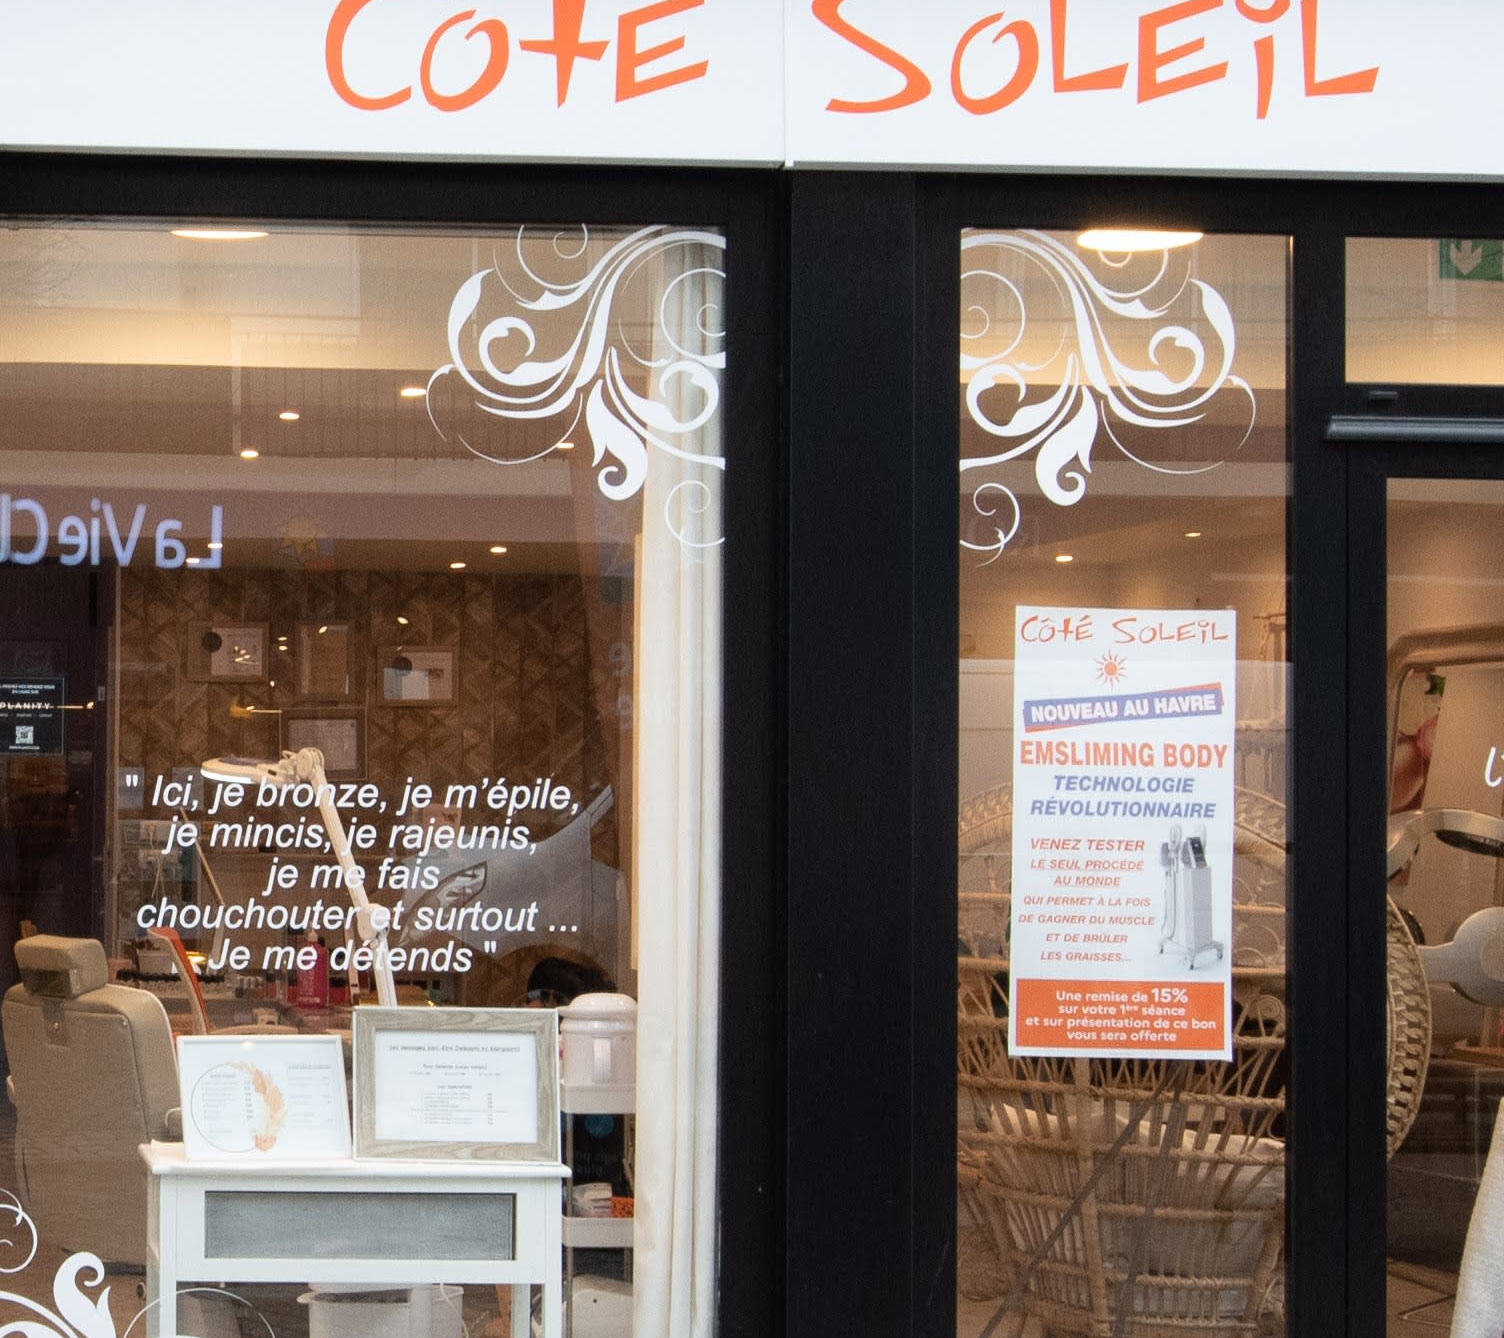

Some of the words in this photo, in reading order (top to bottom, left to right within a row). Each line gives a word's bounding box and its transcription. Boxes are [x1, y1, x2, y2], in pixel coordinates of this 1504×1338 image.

[1031, 701, 1118, 723] NOUVEAU
[1124, 699, 1149, 716] AU
[1154, 694, 1216, 714] HAVRE
[1020, 740, 1154, 767] EMSLIMING
[1163, 743, 1228, 769] BODY
[1054, 775, 1195, 793] TECHNOLOGIE
[151, 774, 199, 812] Ici,
[208, 779, 245, 813] je
[256, 778, 388, 813] bronze,
[396, 780, 433, 816] je
[1030, 796, 1216, 819] RÉVOLUTIONNAIRE
[162, 816, 198, 855] je
[209, 817, 331, 853] mincis,
[340, 818, 378, 856] je
[388, 820, 538, 856] rajeunis,
[1030, 838, 1082, 850] VENEZ
[1087, 839, 1145, 851] TESTER
[1030, 859, 1046, 869] LE
[1050, 859, 1081, 869] SEUL
[262, 858, 299, 896] je
[310, 862, 366, 890] me
[377, 858, 441, 890] fais
[1054, 876, 1072, 886] AU
[1075, 876, 1120, 886] MONDE
[1024, 895, 1043, 906] QUI
[1046, 896, 1094, 906] PERMET
[1108, 897, 1122, 906] LA
[1126, 897, 1151, 907] FOIS
[136, 897, 358, 930] chouchouter
[370, 905, 404, 931] et
[414, 901, 539, 933] surtout
[1018, 914, 1035, 923] DE
[1038, 915, 1086, 925] GAGNER
[1088, 915, 1106, 925] DU
[1108, 916, 1155, 925] MUSCLE
[1046, 933, 1061, 942] ET
[1064, 933, 1080, 943] DE
[208, 938, 251, 972] Je
[262, 944, 318, 972] me
[329, 939, 473, 972] détends
[1056, 990, 1082, 1002] Une
[1086, 991, 1129, 1002] remise
[1131, 991, 1149, 1003] de
[1152, 988, 1189, 1004] 15%
[1058, 1005, 1078, 1014] sur
[1081, 1005, 1117, 1015] votre
[1142, 1005, 1185, 1016] séance
[1025, 1017, 1040, 1026] et
[1043, 1018, 1064, 1027] sur
[1067, 1017, 1150, 1029] présentation
[1154, 1018, 1169, 1029] de
[1173, 1020, 1188, 1029] ce
[1191, 1019, 1217, 1029] bon
[1067, 1031, 1097, 1040] vous
[1100, 1032, 1127, 1041] sera
[1130, 1031, 1177, 1042] offerte
